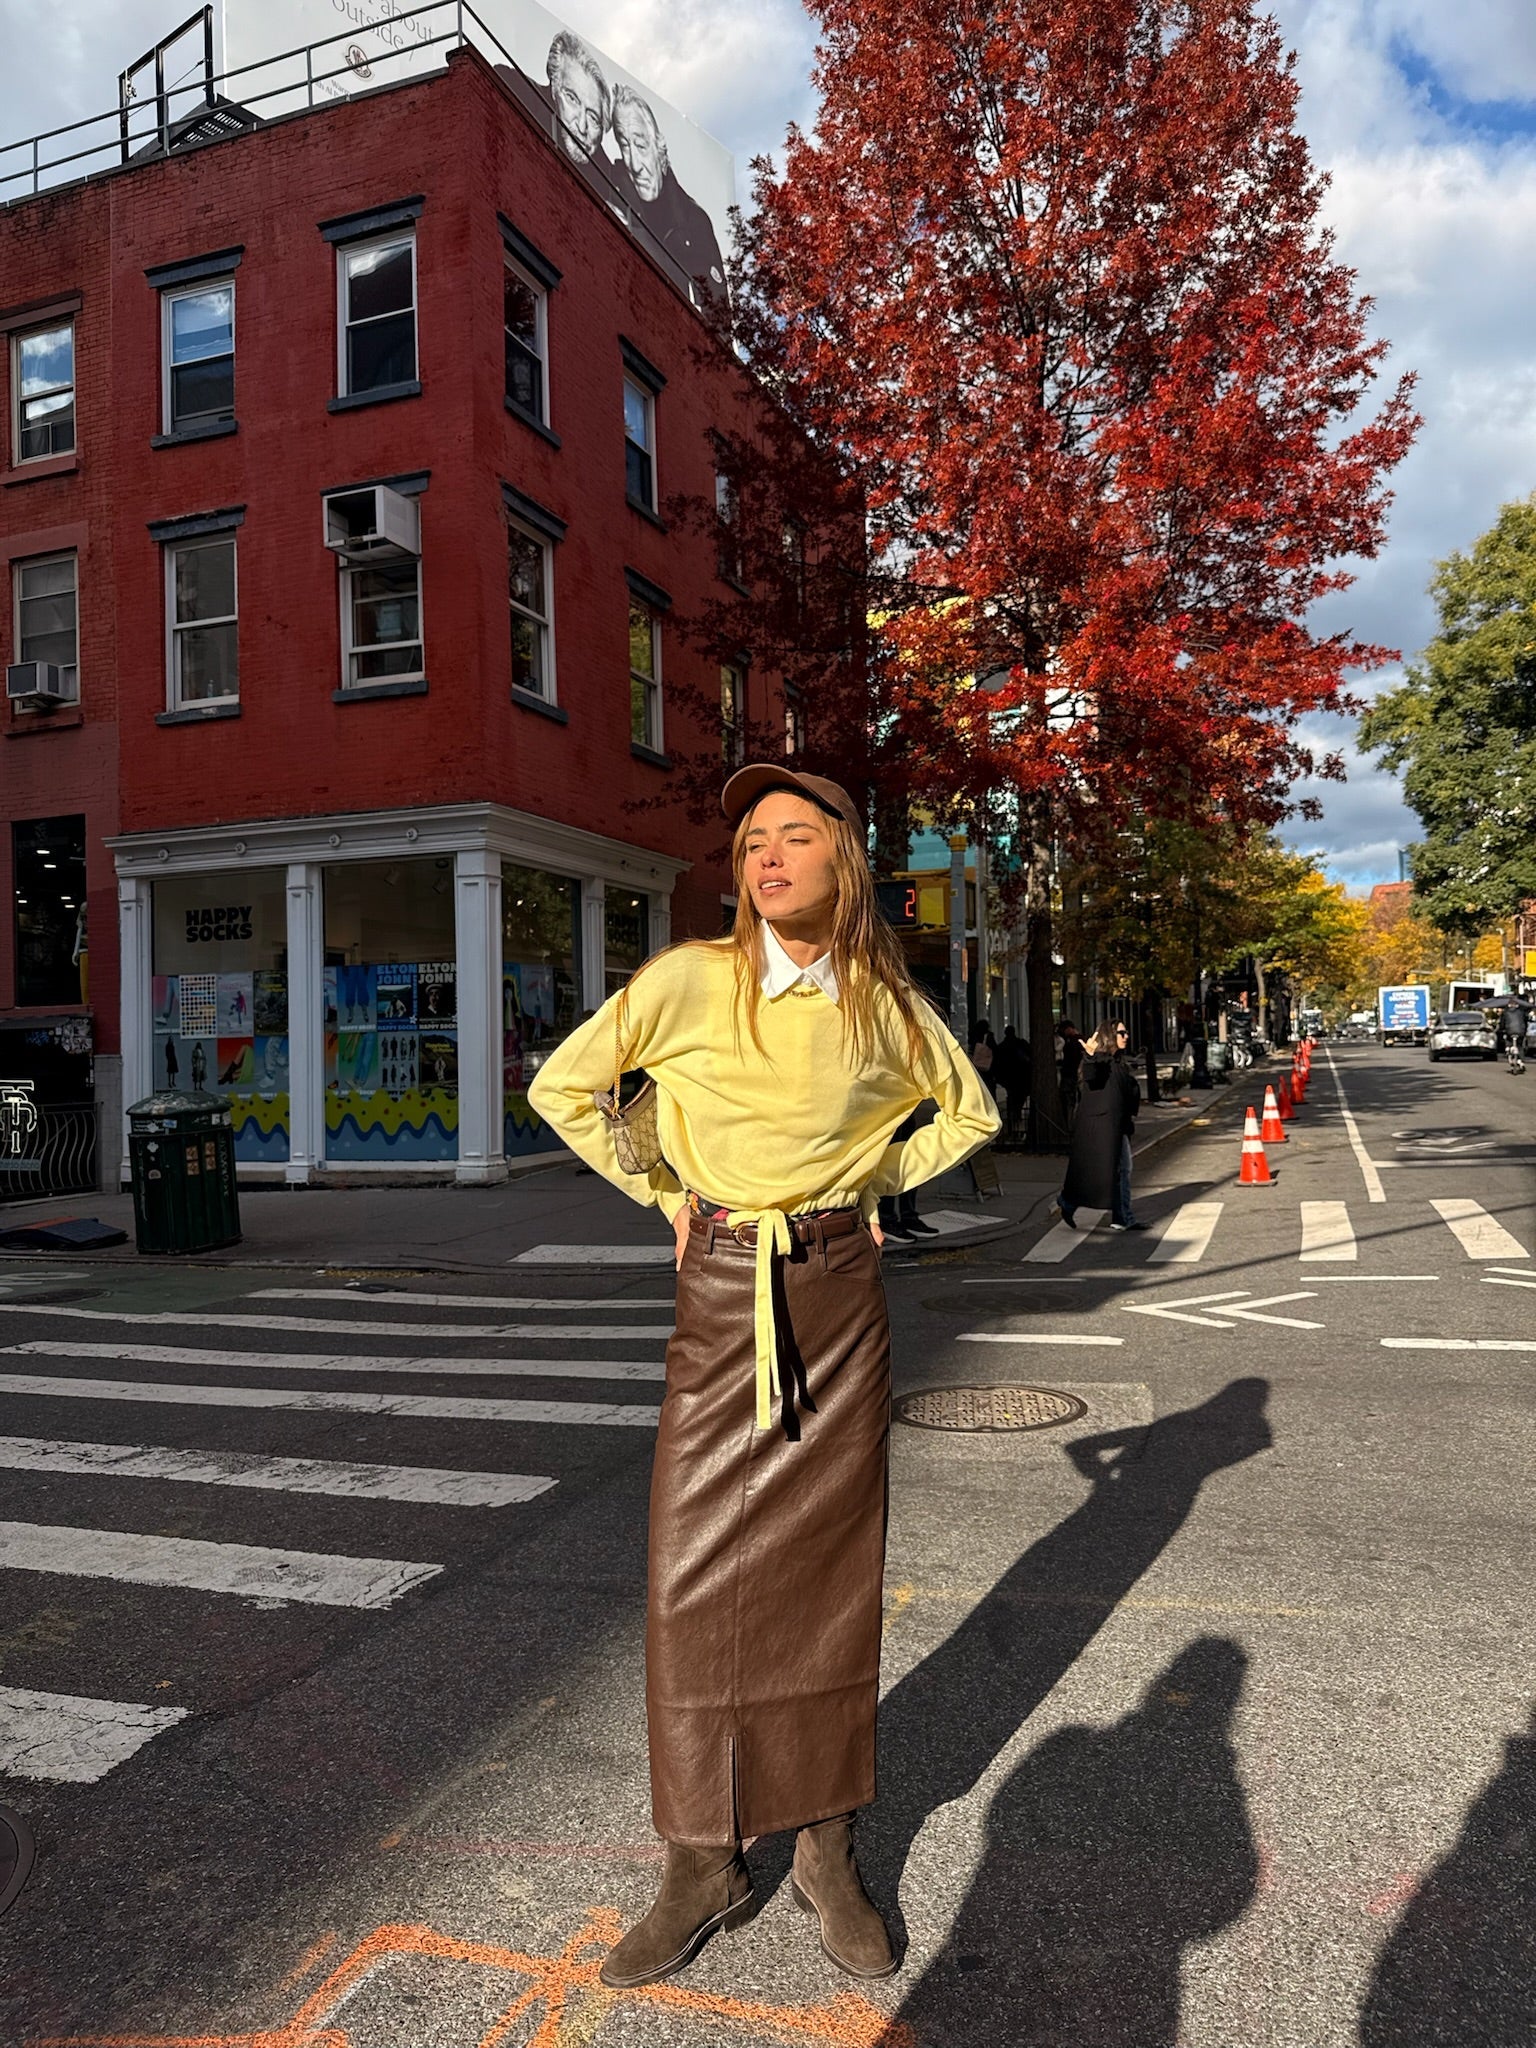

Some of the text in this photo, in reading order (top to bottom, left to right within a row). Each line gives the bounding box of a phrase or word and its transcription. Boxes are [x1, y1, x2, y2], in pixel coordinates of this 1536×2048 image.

[905, 888, 916, 917] 2
[185, 906, 252, 926] HAPPY
[186, 923, 253, 942] SOCKS
[377, 964, 417, 974] ELTON
[418, 962, 456, 973] ELTON
[377, 974, 411, 985] JOHN
[418, 973, 454, 984] JOHN
